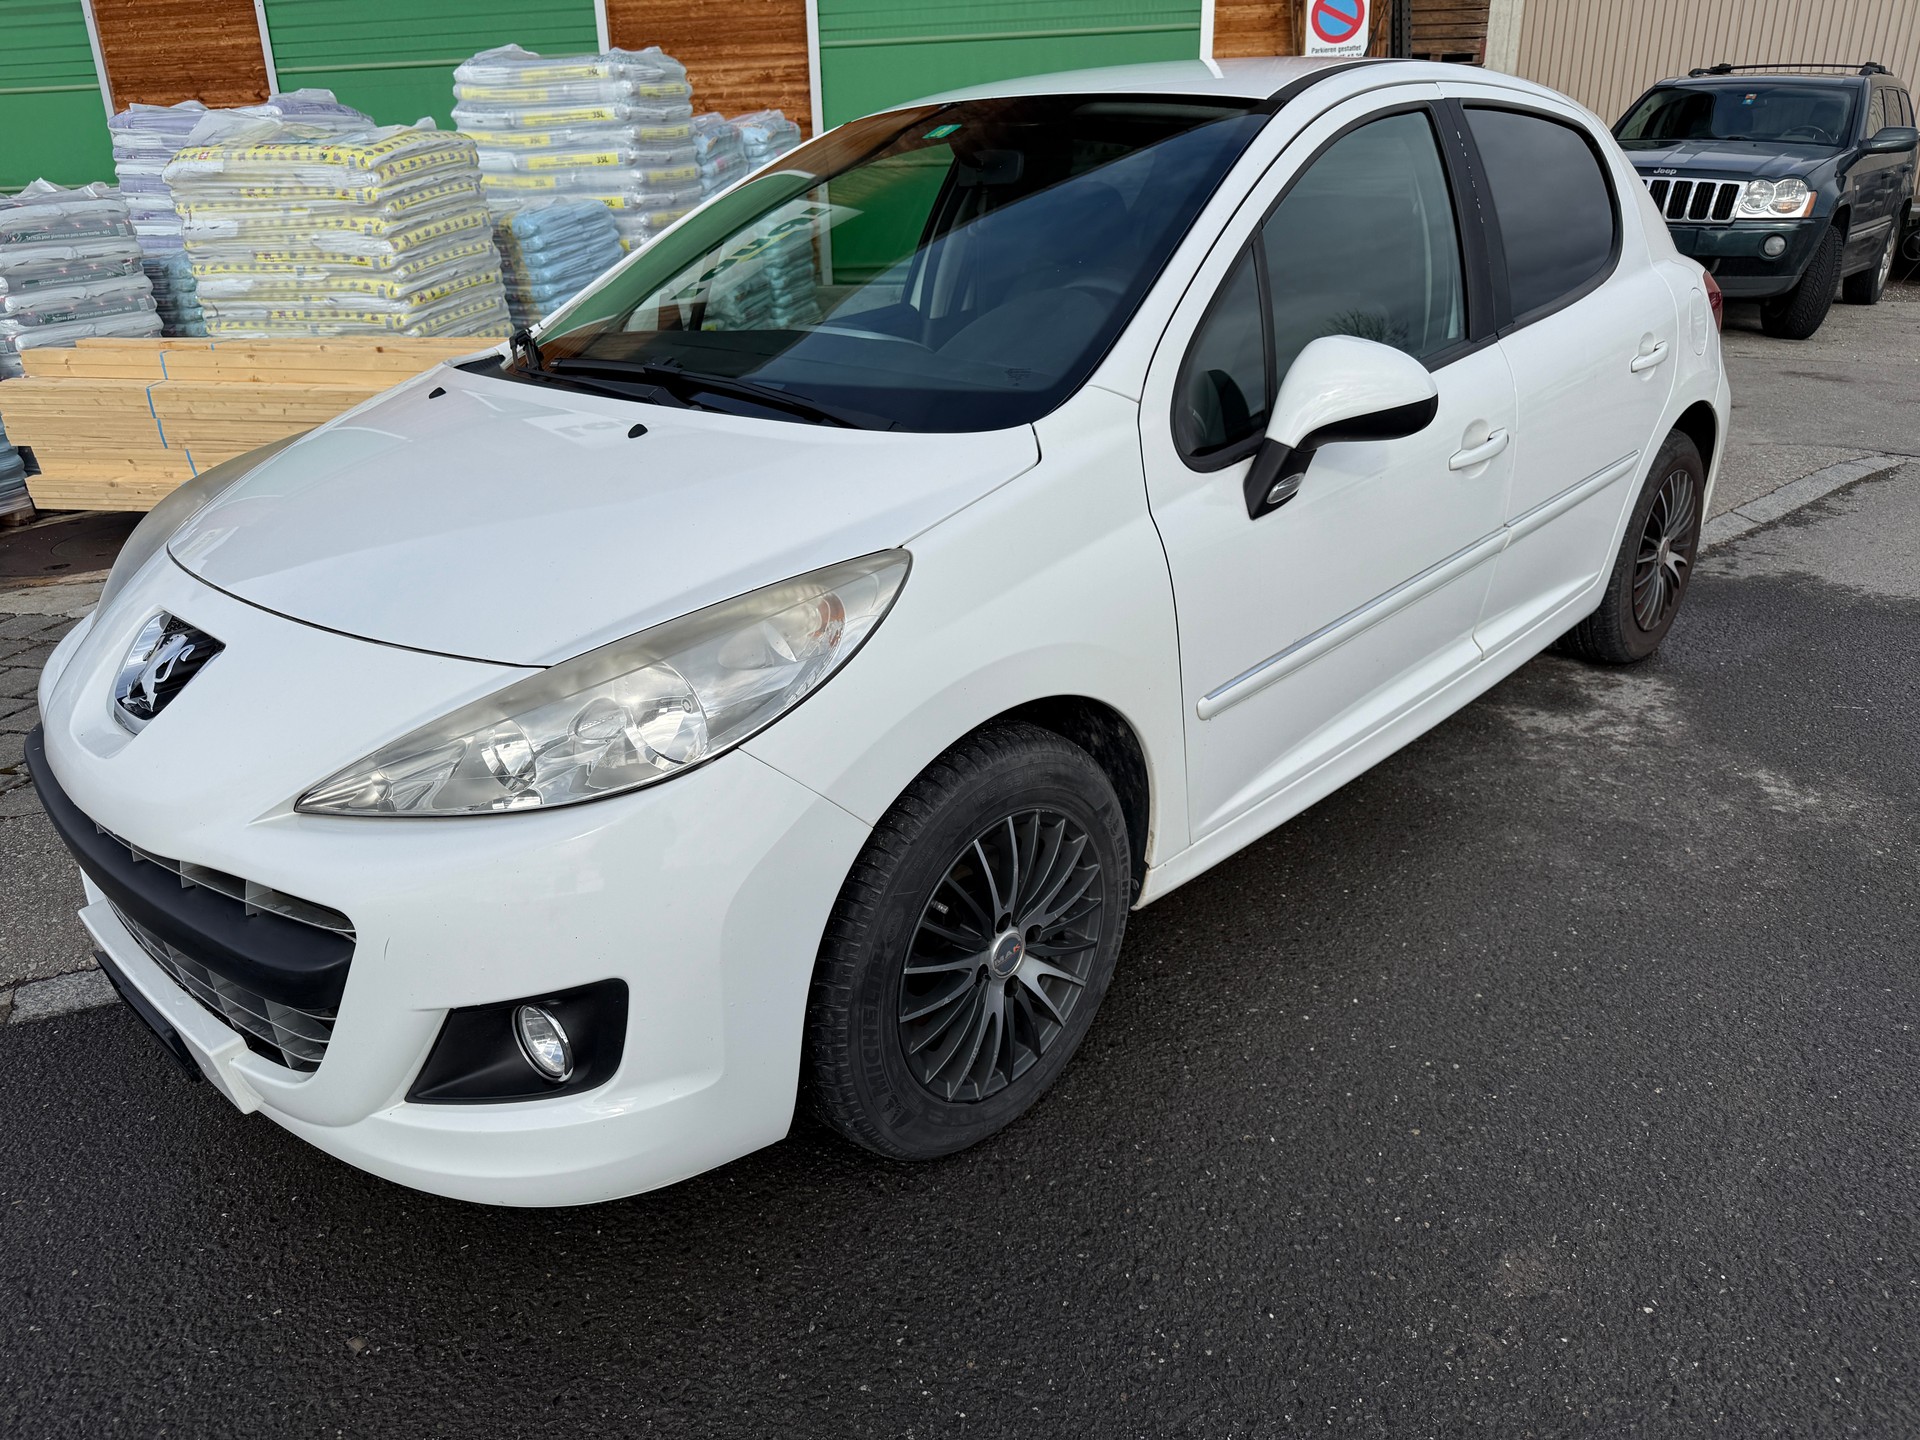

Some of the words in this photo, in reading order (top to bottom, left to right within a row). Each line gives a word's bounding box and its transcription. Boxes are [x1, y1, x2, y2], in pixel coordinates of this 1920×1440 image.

[1338, 45, 1361, 53] gestattet
[593, 111, 605, 119] 35L
[596, 156, 609, 164] 35L
[1653, 167, 1677, 175] Jeep
[1112, 834, 1129, 957] MICHELIN
[994, 943, 1021, 967] MAK
